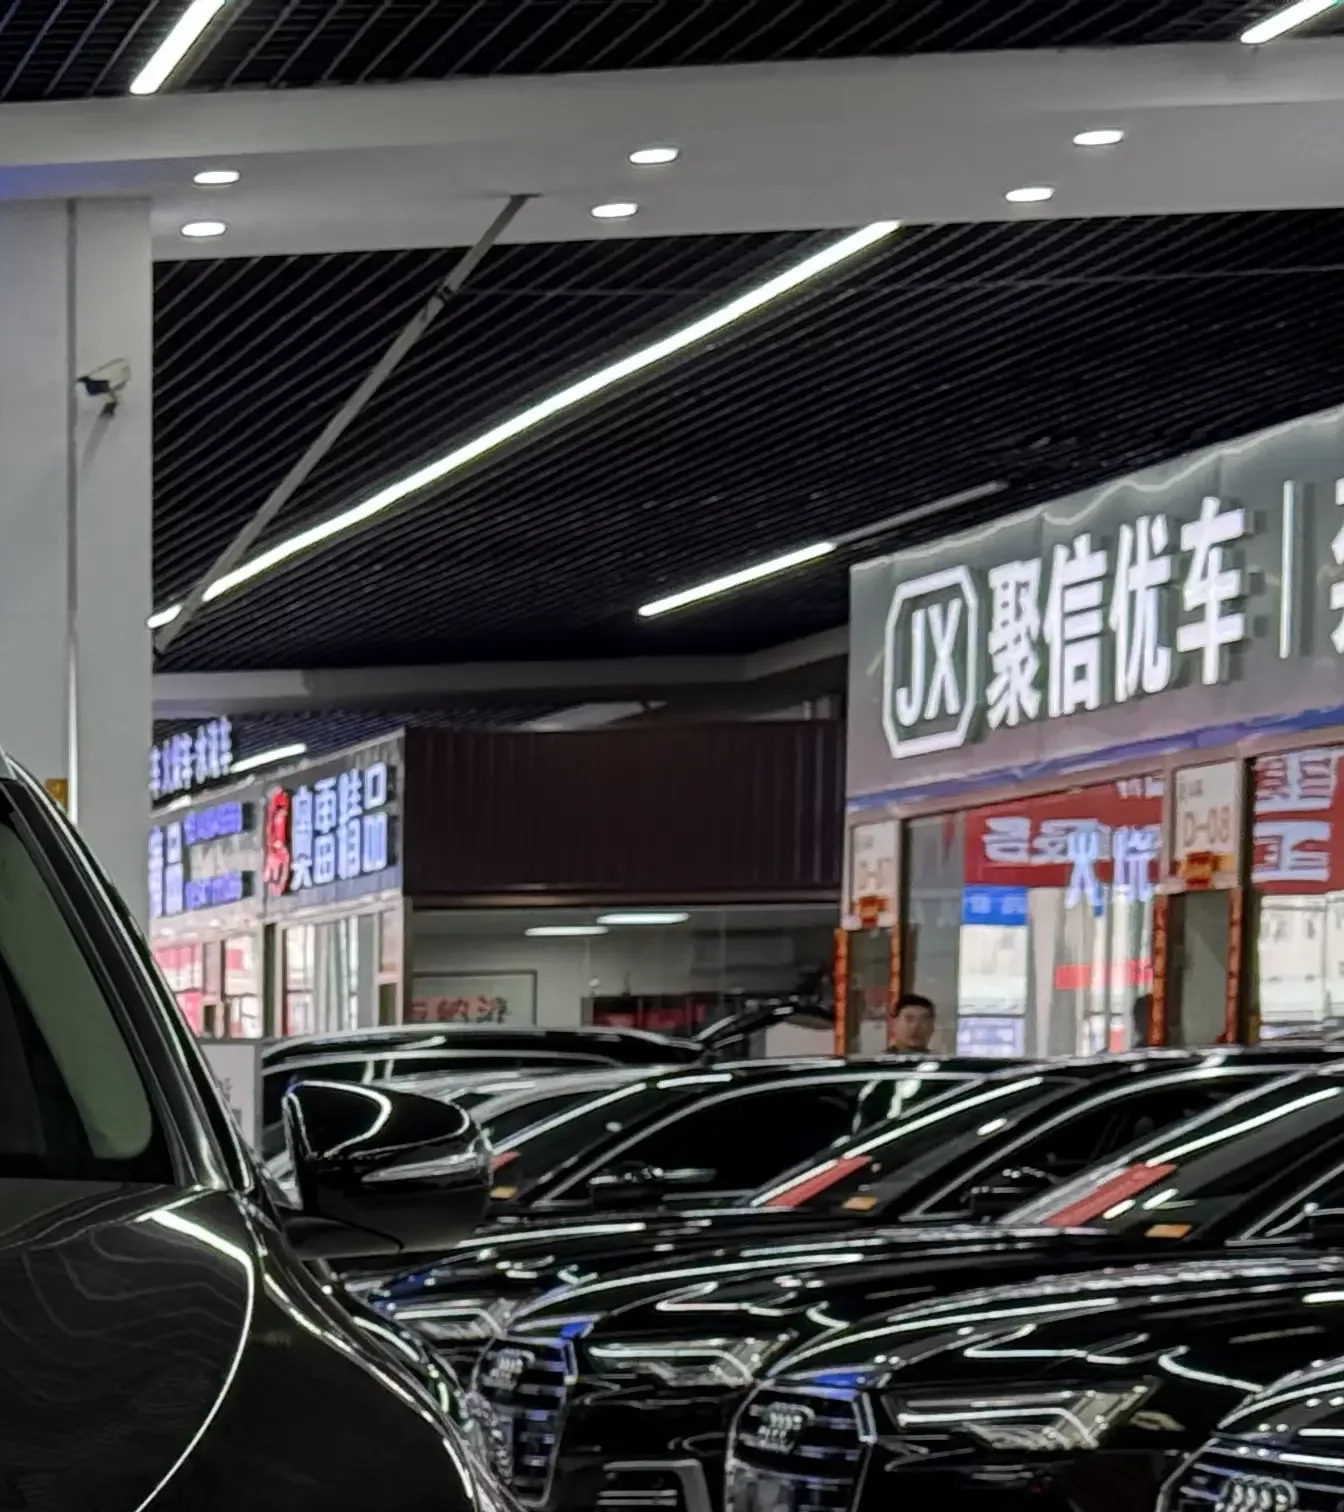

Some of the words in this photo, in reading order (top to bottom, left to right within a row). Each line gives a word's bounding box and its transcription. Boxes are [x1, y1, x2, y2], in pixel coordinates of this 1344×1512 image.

[895, 598, 963, 727] JX
[985, 497, 1246, 729] 聚信优车
